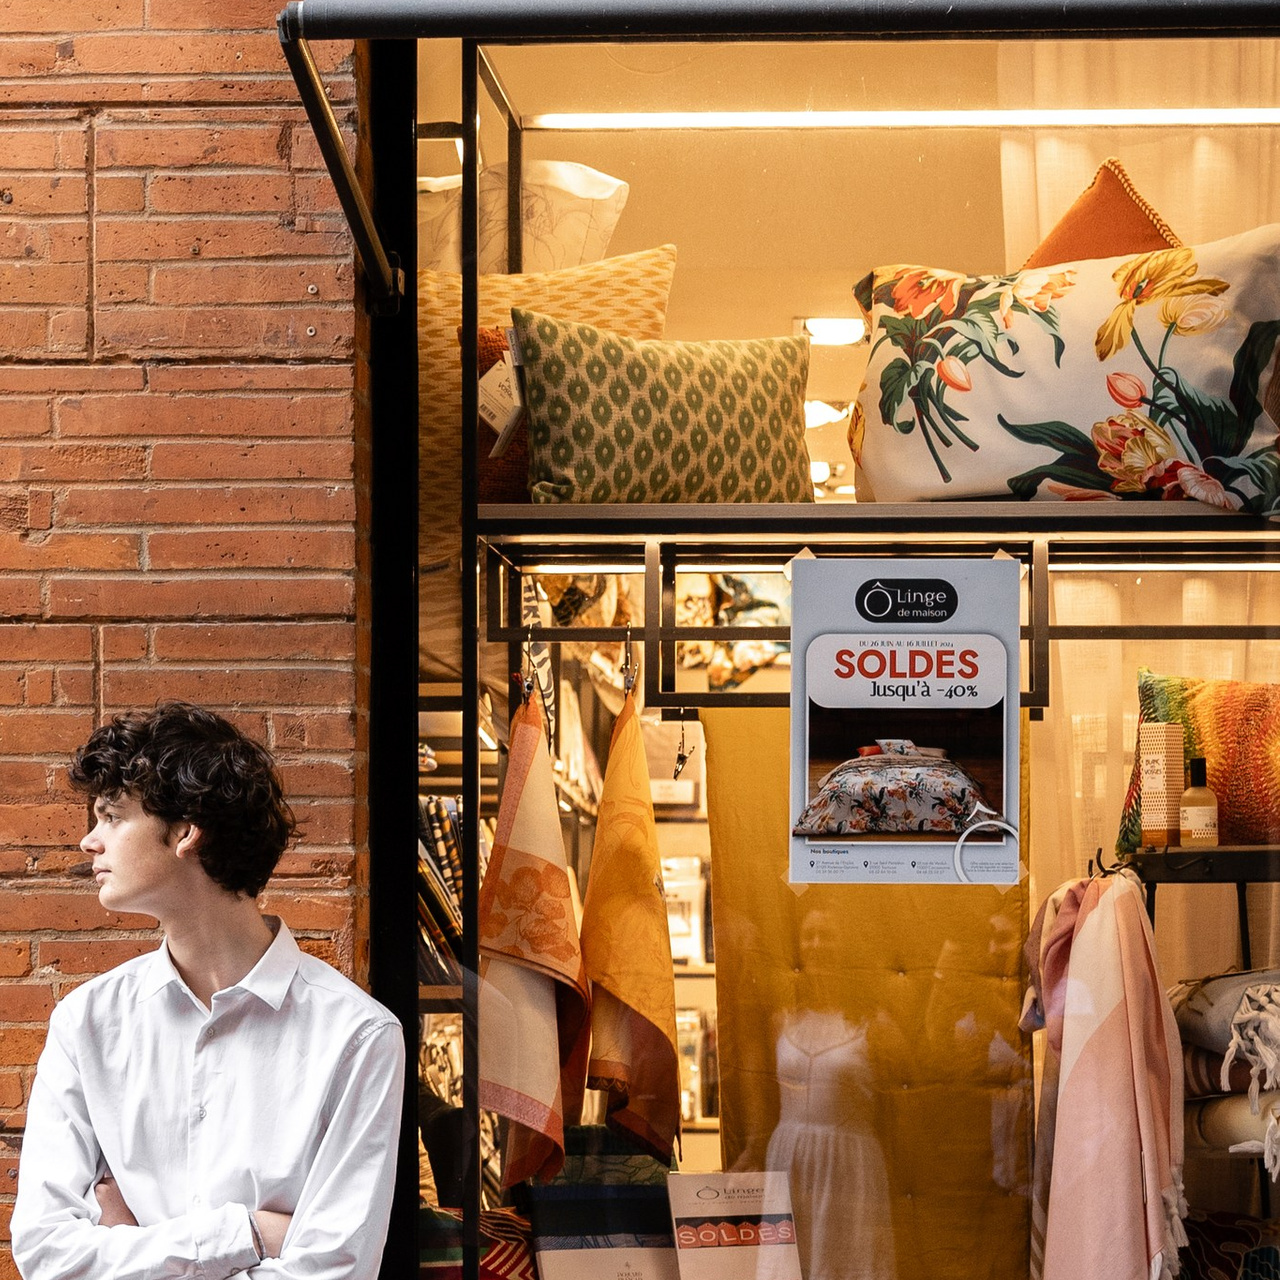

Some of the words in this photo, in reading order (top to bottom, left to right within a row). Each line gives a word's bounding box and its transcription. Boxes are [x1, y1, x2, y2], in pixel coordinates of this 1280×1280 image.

[897, 589, 947, 607] Linge
[897, 608, 910, 617] de
[912, 608, 948, 617] maison
[870, 640, 879, 648] 26
[906, 640, 914, 648] 16
[915, 640, 938, 648] JUILLET
[834, 649, 979, 679] SOLDES
[870, 680, 931, 702] Jusqu'à
[936, 685, 978, 699] -40%
[679, 1227, 791, 1244] SOLDES
